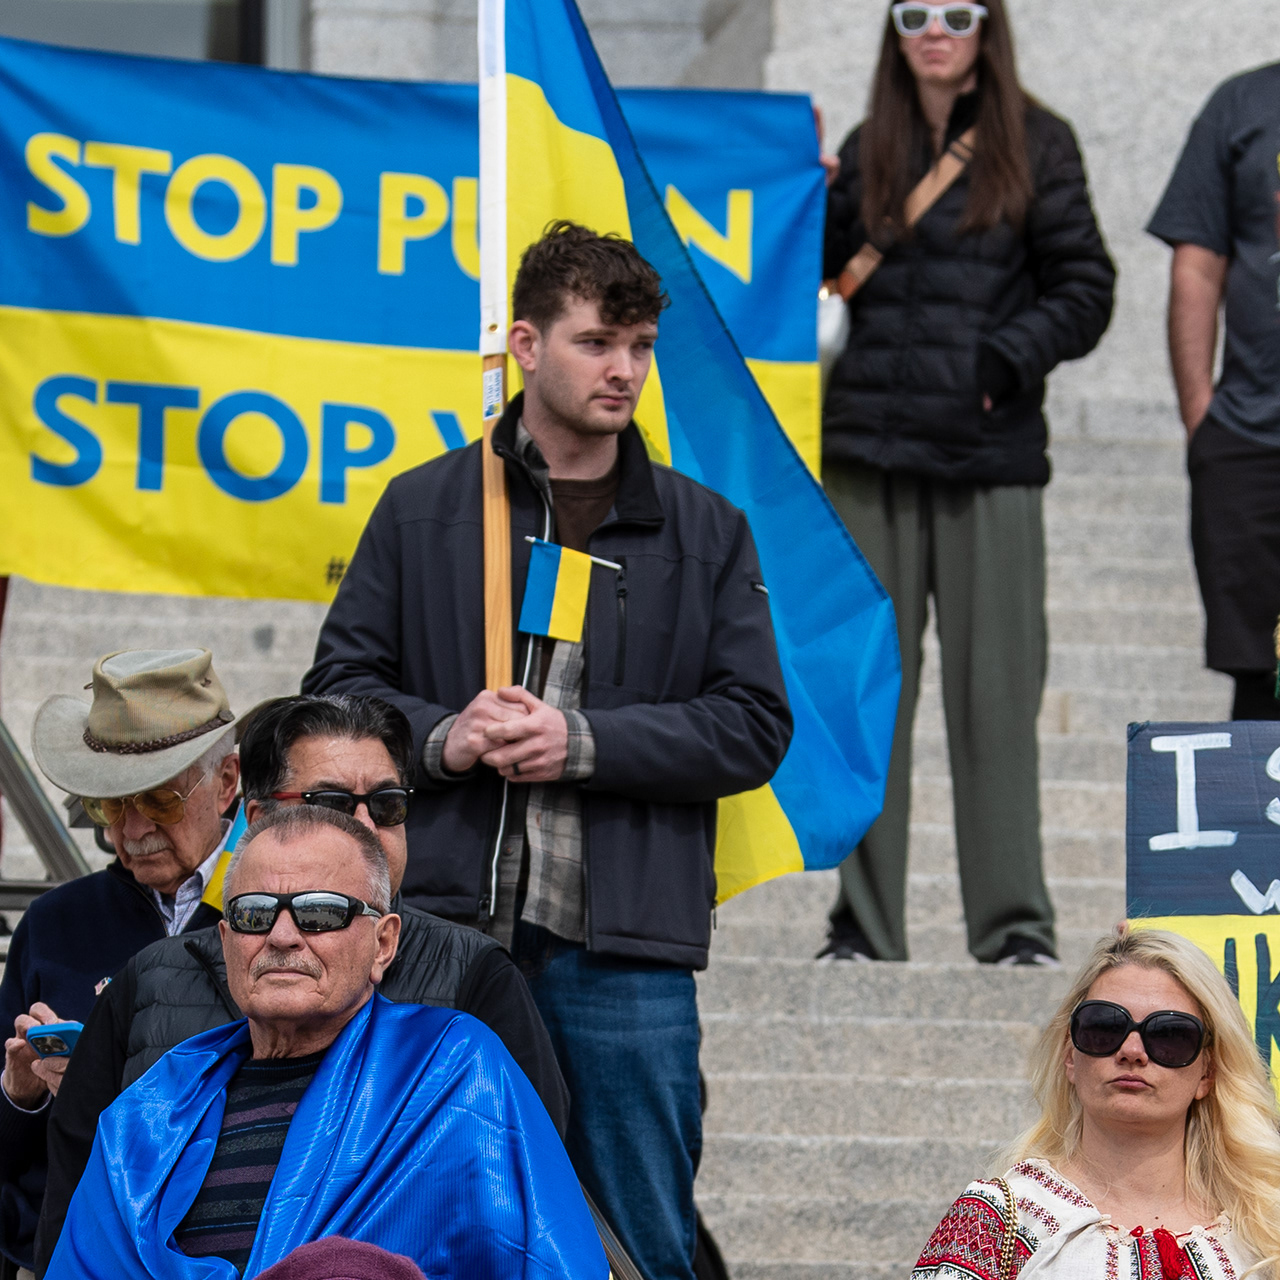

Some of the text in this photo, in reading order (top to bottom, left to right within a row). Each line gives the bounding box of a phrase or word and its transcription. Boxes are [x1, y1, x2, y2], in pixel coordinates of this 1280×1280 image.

[25, 132, 344, 266] STOP
[30, 373, 397, 506] STOP
[1149, 732, 1239, 852] I
